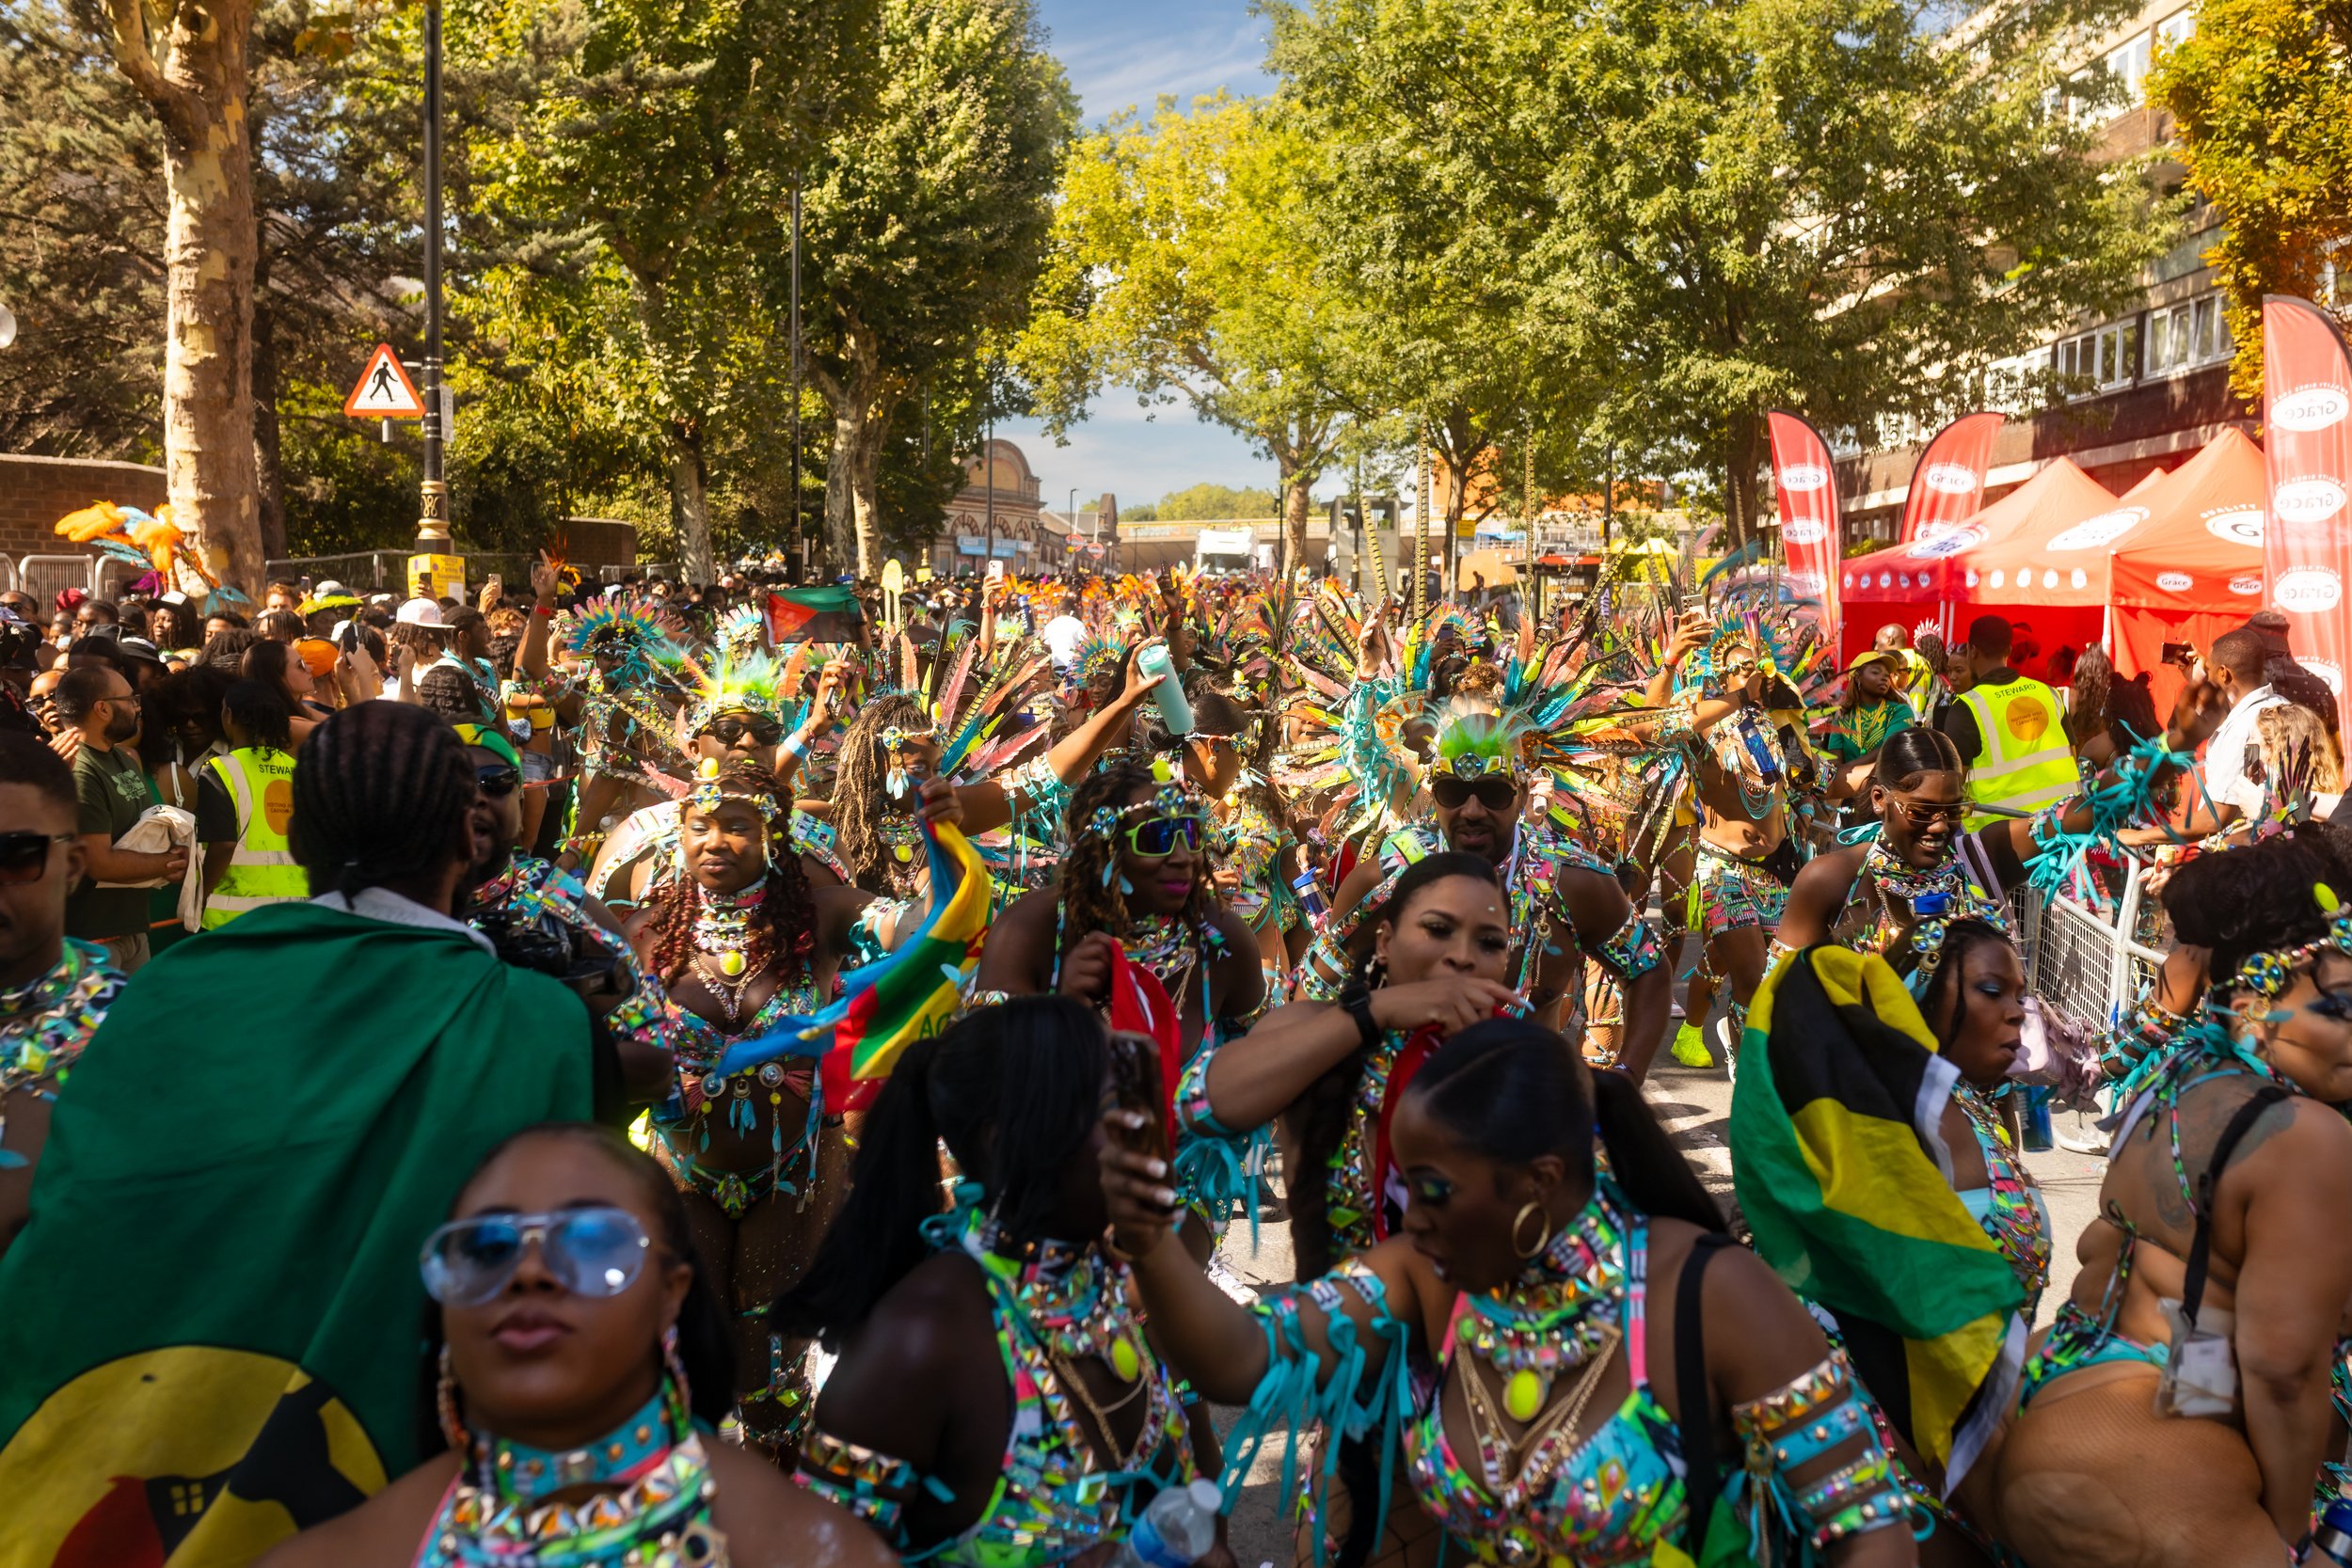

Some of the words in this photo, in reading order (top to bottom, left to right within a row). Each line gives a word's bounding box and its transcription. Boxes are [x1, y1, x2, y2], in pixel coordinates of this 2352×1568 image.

[1931, 472, 1967, 486] Grace
[2200, 503, 2256, 518] QUALITY
[2160, 578, 2188, 587] Grace
[2233, 582, 2260, 591] Grace
[1563, 592, 1583, 601] YOU
[1994, 683, 2037, 699] STEWARD
